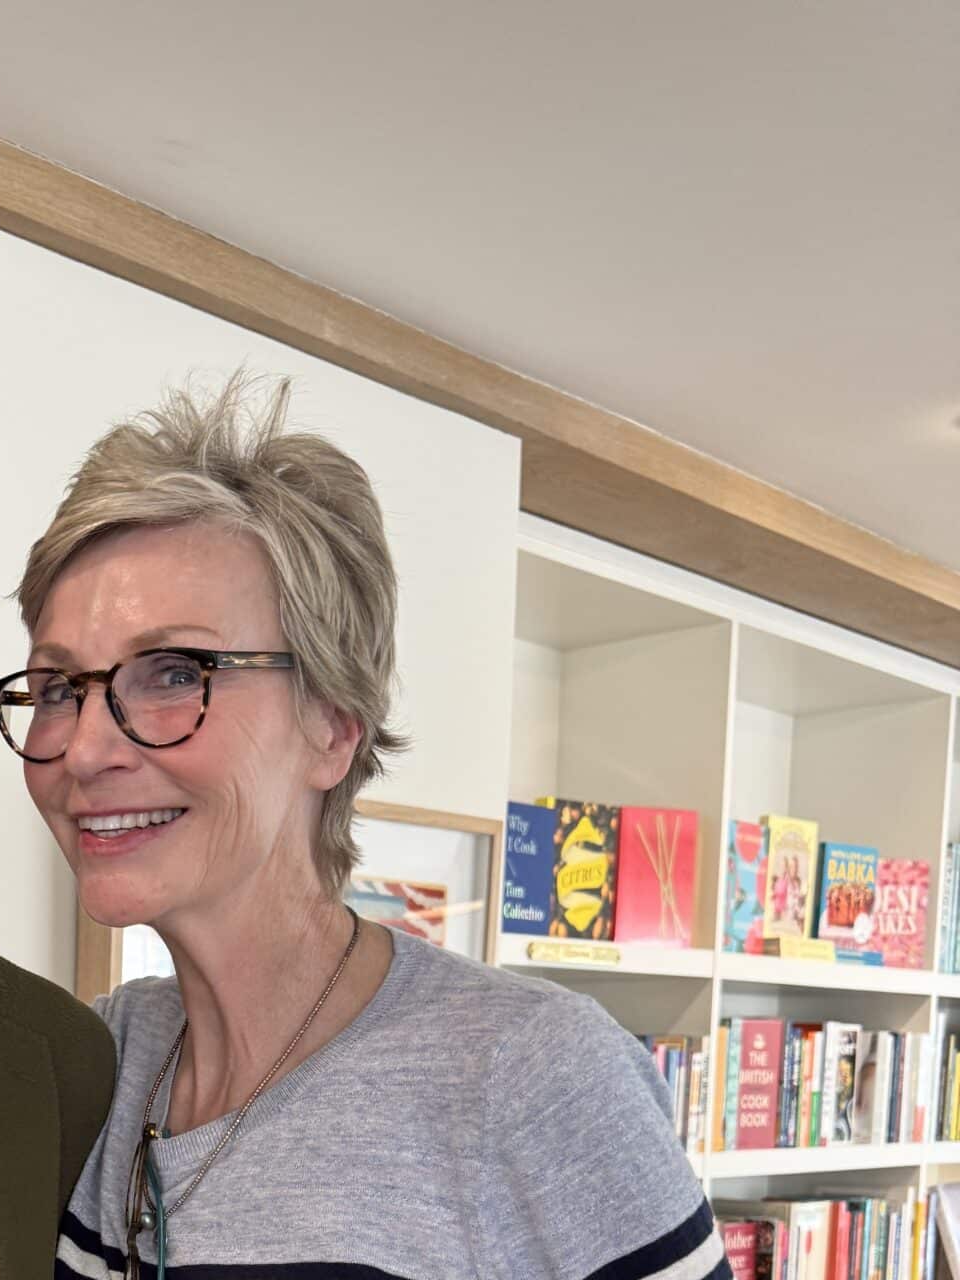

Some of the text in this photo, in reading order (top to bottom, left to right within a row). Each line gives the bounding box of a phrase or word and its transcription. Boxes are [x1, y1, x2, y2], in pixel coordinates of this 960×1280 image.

[508, 815, 529, 836] Why
[514, 837, 537, 856] Cook
[561, 866, 603, 889] CITRUS
[827, 859, 875, 883] BABKA
[505, 881, 525, 898] Tom
[748, 1051, 768, 1067] THE
[740, 1094, 770, 1110] COOK
[739, 1112, 769, 1128] BOOK
[724, 1230, 754, 1249] other
